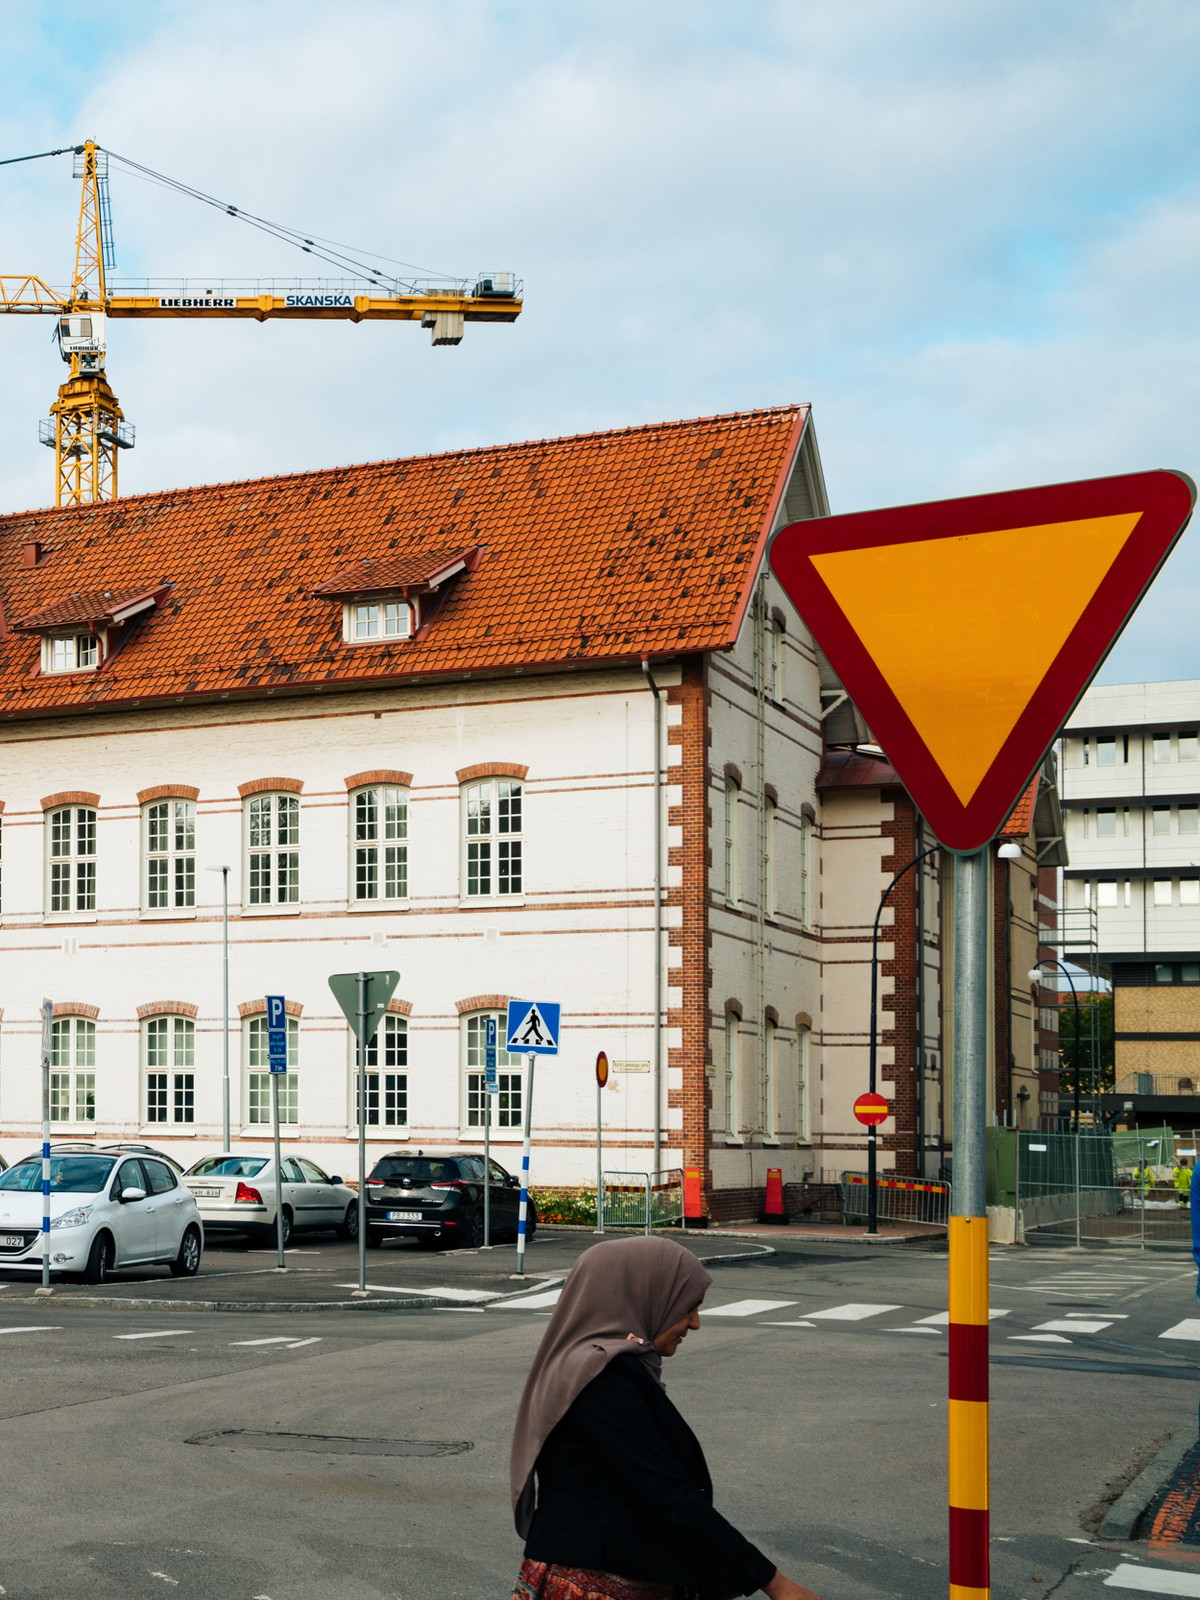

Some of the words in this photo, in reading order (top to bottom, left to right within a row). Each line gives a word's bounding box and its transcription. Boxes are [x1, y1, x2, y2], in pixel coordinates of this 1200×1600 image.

[160, 298, 234, 307] LIEBHERR
[286, 295, 353, 306] SKANSKA
[271, 999, 282, 1026] P
[488, 1021, 495, 1045] P
[6, 1237, 22, 1246] 027
